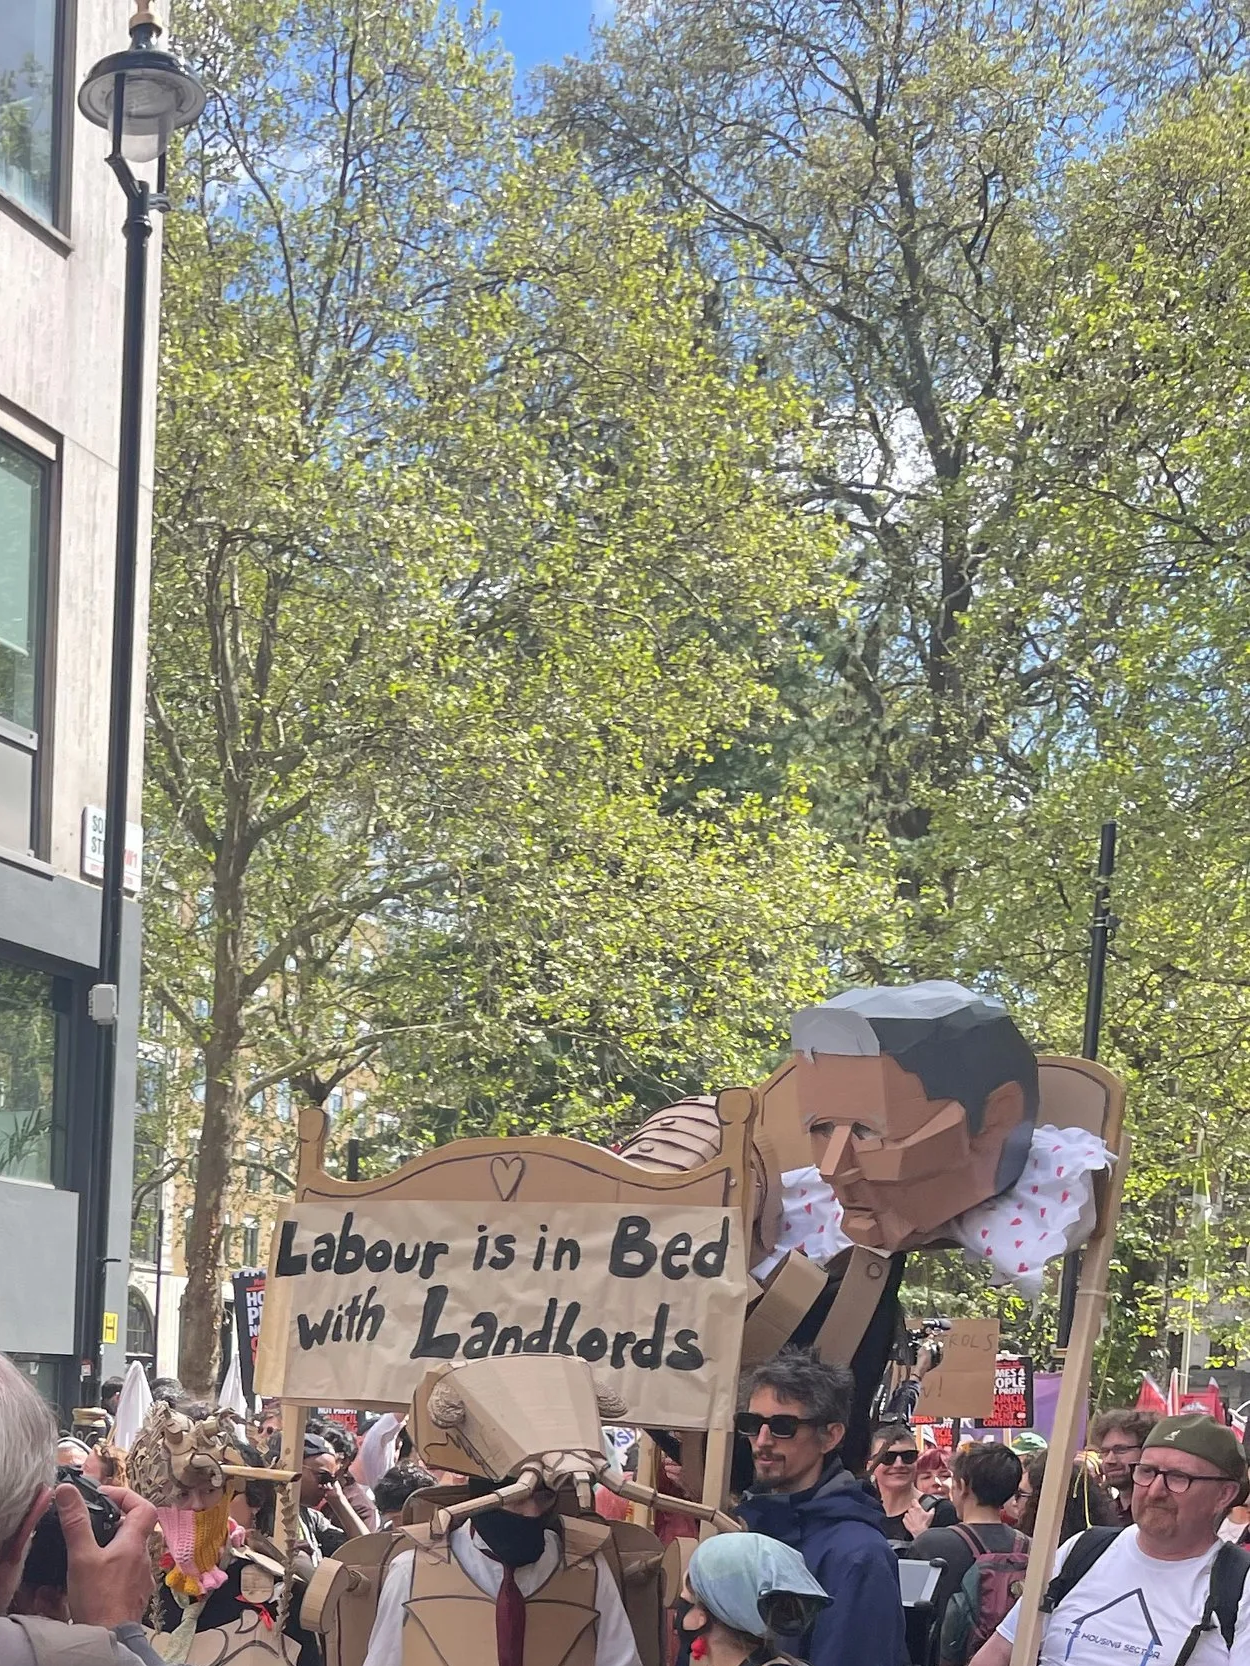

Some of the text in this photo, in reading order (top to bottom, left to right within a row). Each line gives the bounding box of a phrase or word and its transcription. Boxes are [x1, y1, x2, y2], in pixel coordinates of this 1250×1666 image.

[276, 1212, 730, 1280] Labour is in Bed
[104, 1316, 116, 1341] H
[297, 1285, 705, 1371] with Landlords
[995, 1368, 1026, 1377] MES 4
[995, 1377, 1026, 1388] OPLE
[999, 1387, 1026, 1395] PROFIT
[1065, 1628, 1161, 1659] THE HOUSING SECTOR
